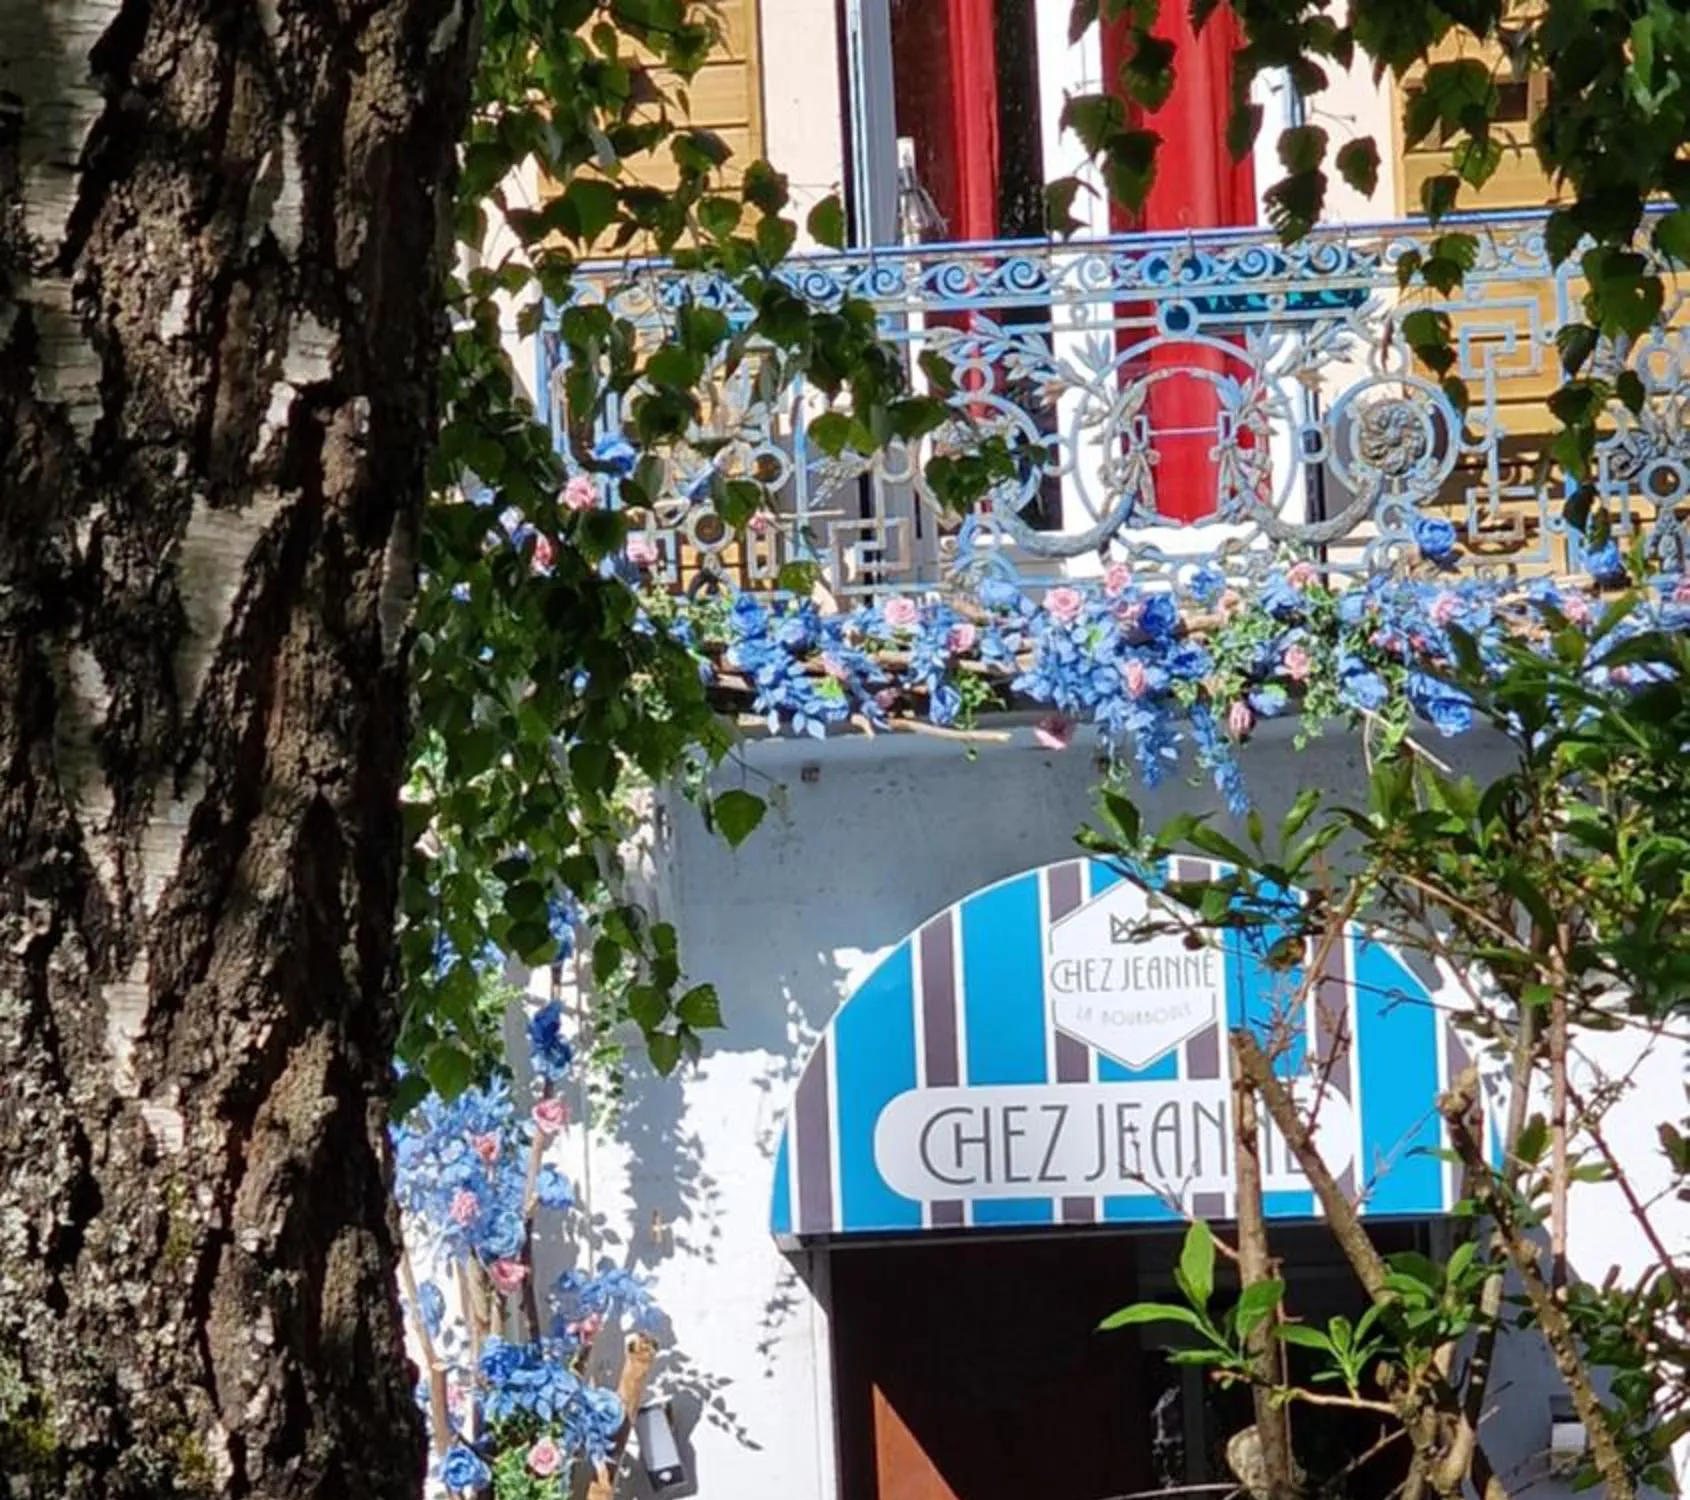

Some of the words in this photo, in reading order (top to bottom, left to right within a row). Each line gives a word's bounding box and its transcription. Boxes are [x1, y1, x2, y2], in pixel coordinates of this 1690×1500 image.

[1050, 958, 1113, 993] CHEZ
[1120, 952, 1216, 991] JEANNE
[919, 1104, 1069, 1185] CHEZ
